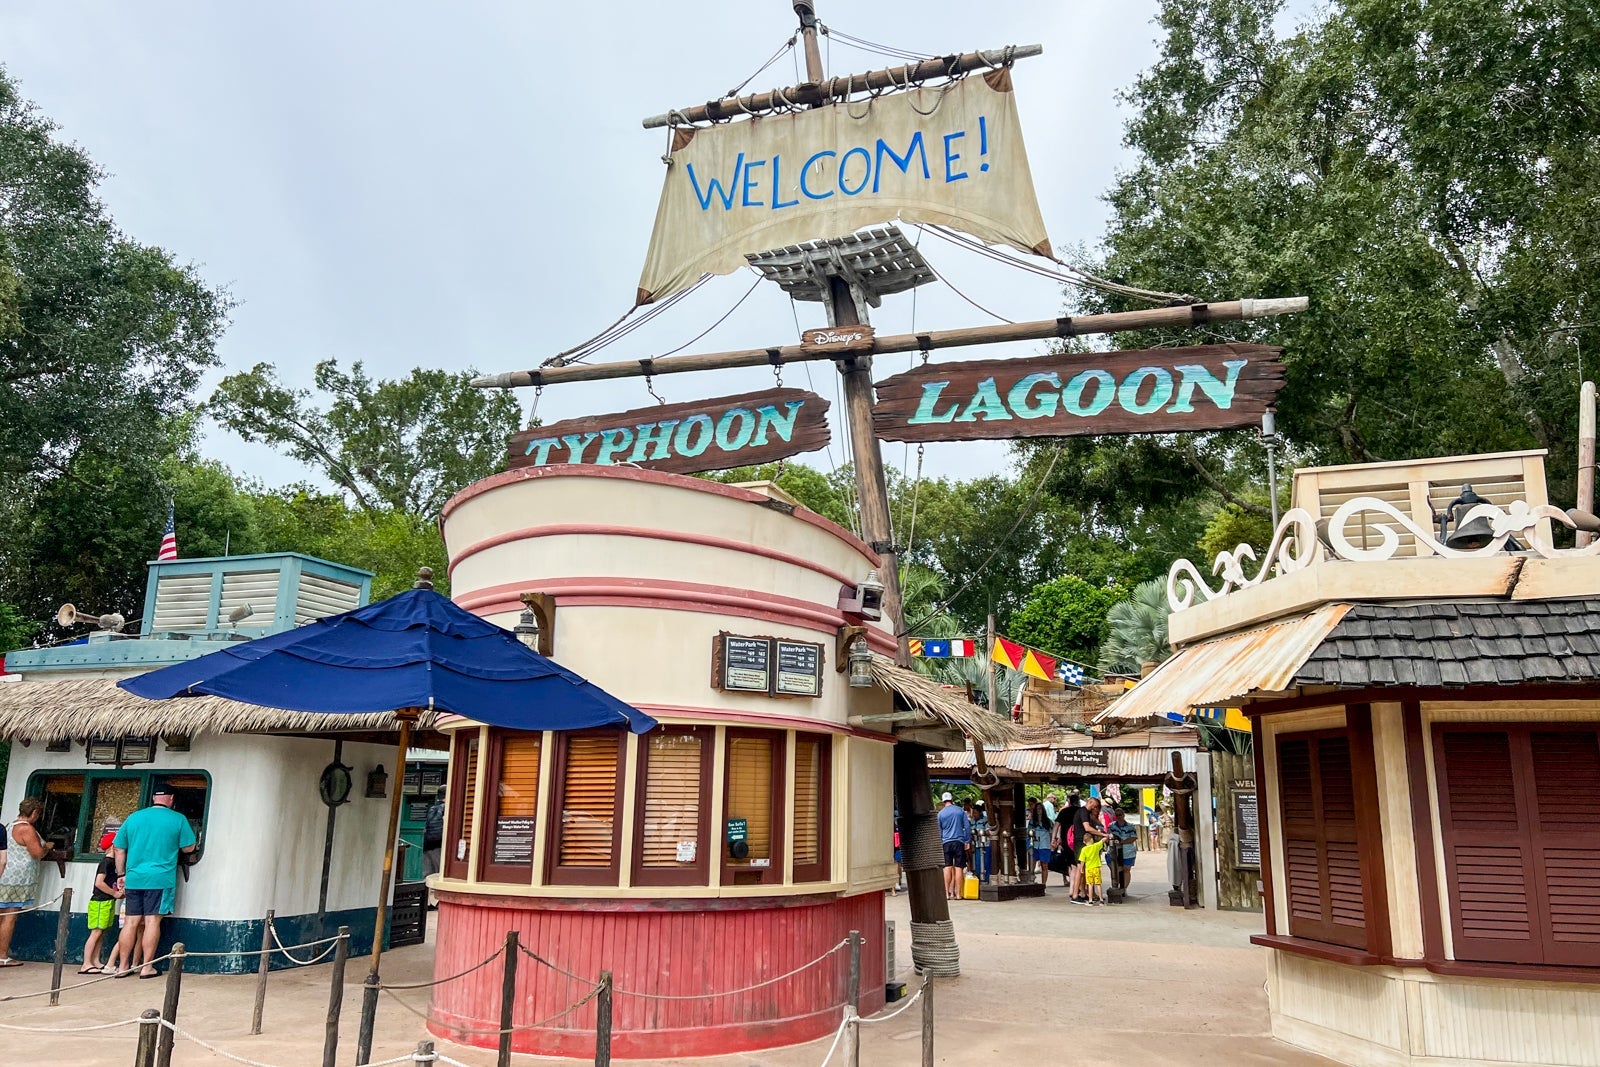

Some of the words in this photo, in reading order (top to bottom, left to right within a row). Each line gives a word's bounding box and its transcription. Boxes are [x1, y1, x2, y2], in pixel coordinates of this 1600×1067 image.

[686, 116, 989, 210] WELCOME!
[812, 331, 862, 346] Disney's
[907, 359, 1248, 424] LAGOON
[525, 400, 804, 467] TYPHOON
